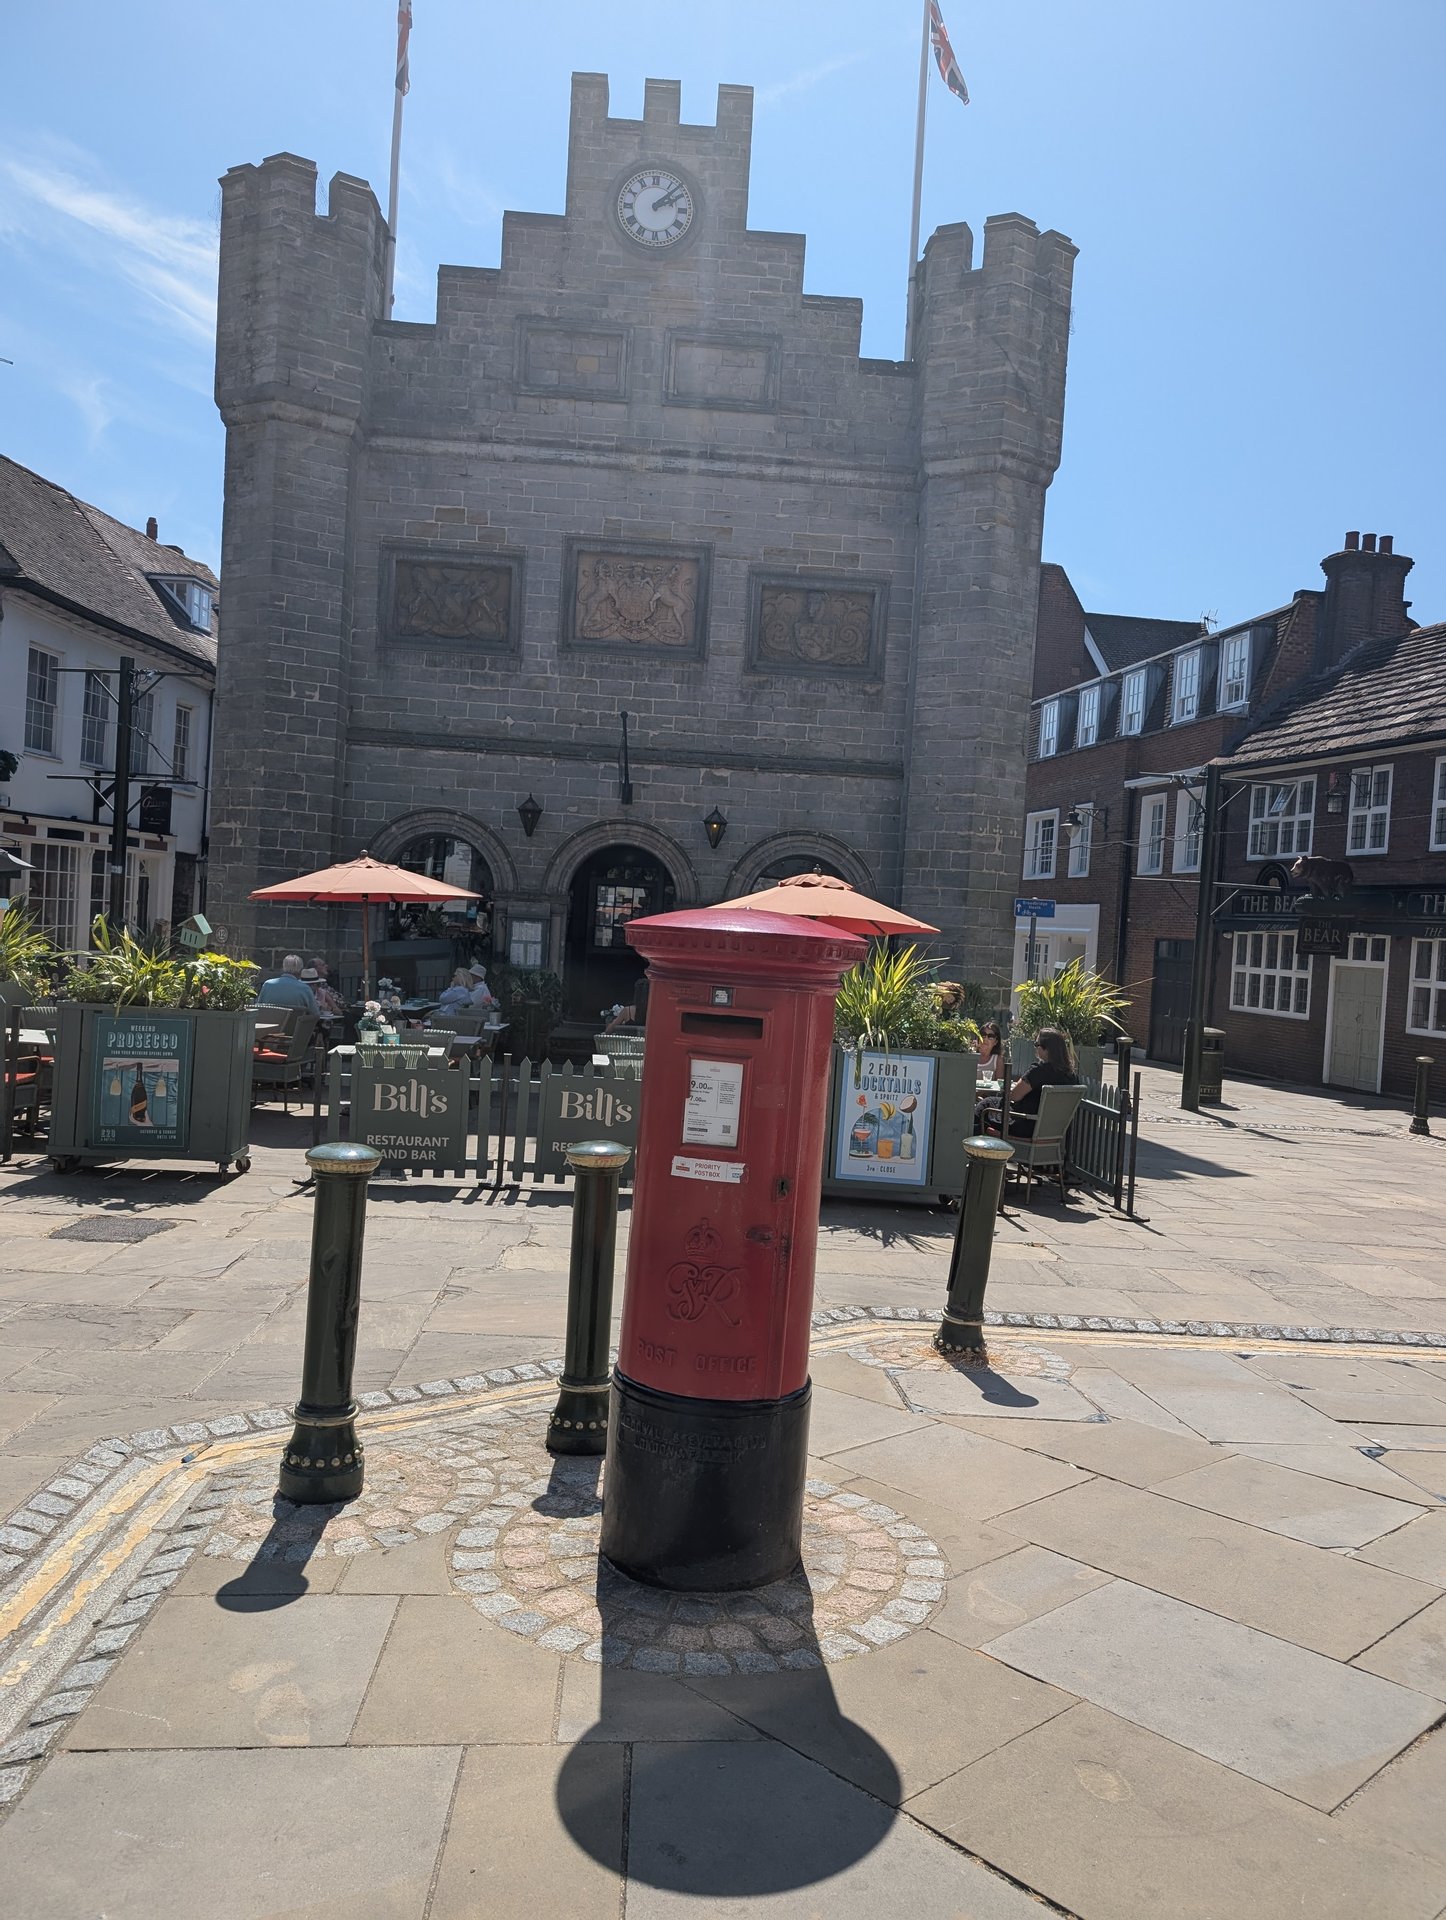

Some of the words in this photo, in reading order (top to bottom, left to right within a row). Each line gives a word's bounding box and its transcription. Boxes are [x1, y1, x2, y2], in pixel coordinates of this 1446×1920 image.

[1241, 895, 1269, 912] THE
[1274, 895, 1298, 912] BEA
[1420, 894, 1446, 913] TH
[1304, 928, 1341, 943] BEAR
[1424, 927, 1445, 937] THE
[107, 1032, 178, 1049] PROSECCO
[868, 1062, 875, 1075] 2
[878, 1063, 898, 1077] FOR
[902, 1065, 908, 1078] 1
[372, 1079, 448, 1118] Bill's
[880, 1093, 899, 1101] SPRITZ
[559, 1087, 633, 1127] Bill's
[366, 1134, 450, 1147] RESTAURANT
[380, 1149, 407, 1159] AND
[411, 1149, 437, 1160] BAR
[695, 1162, 721, 1171] PRIORITY
[880, 1165, 896, 1173] CLOSE
[636, 1337, 678, 1368] POST
[695, 1354, 758, 1375] OFFICE
